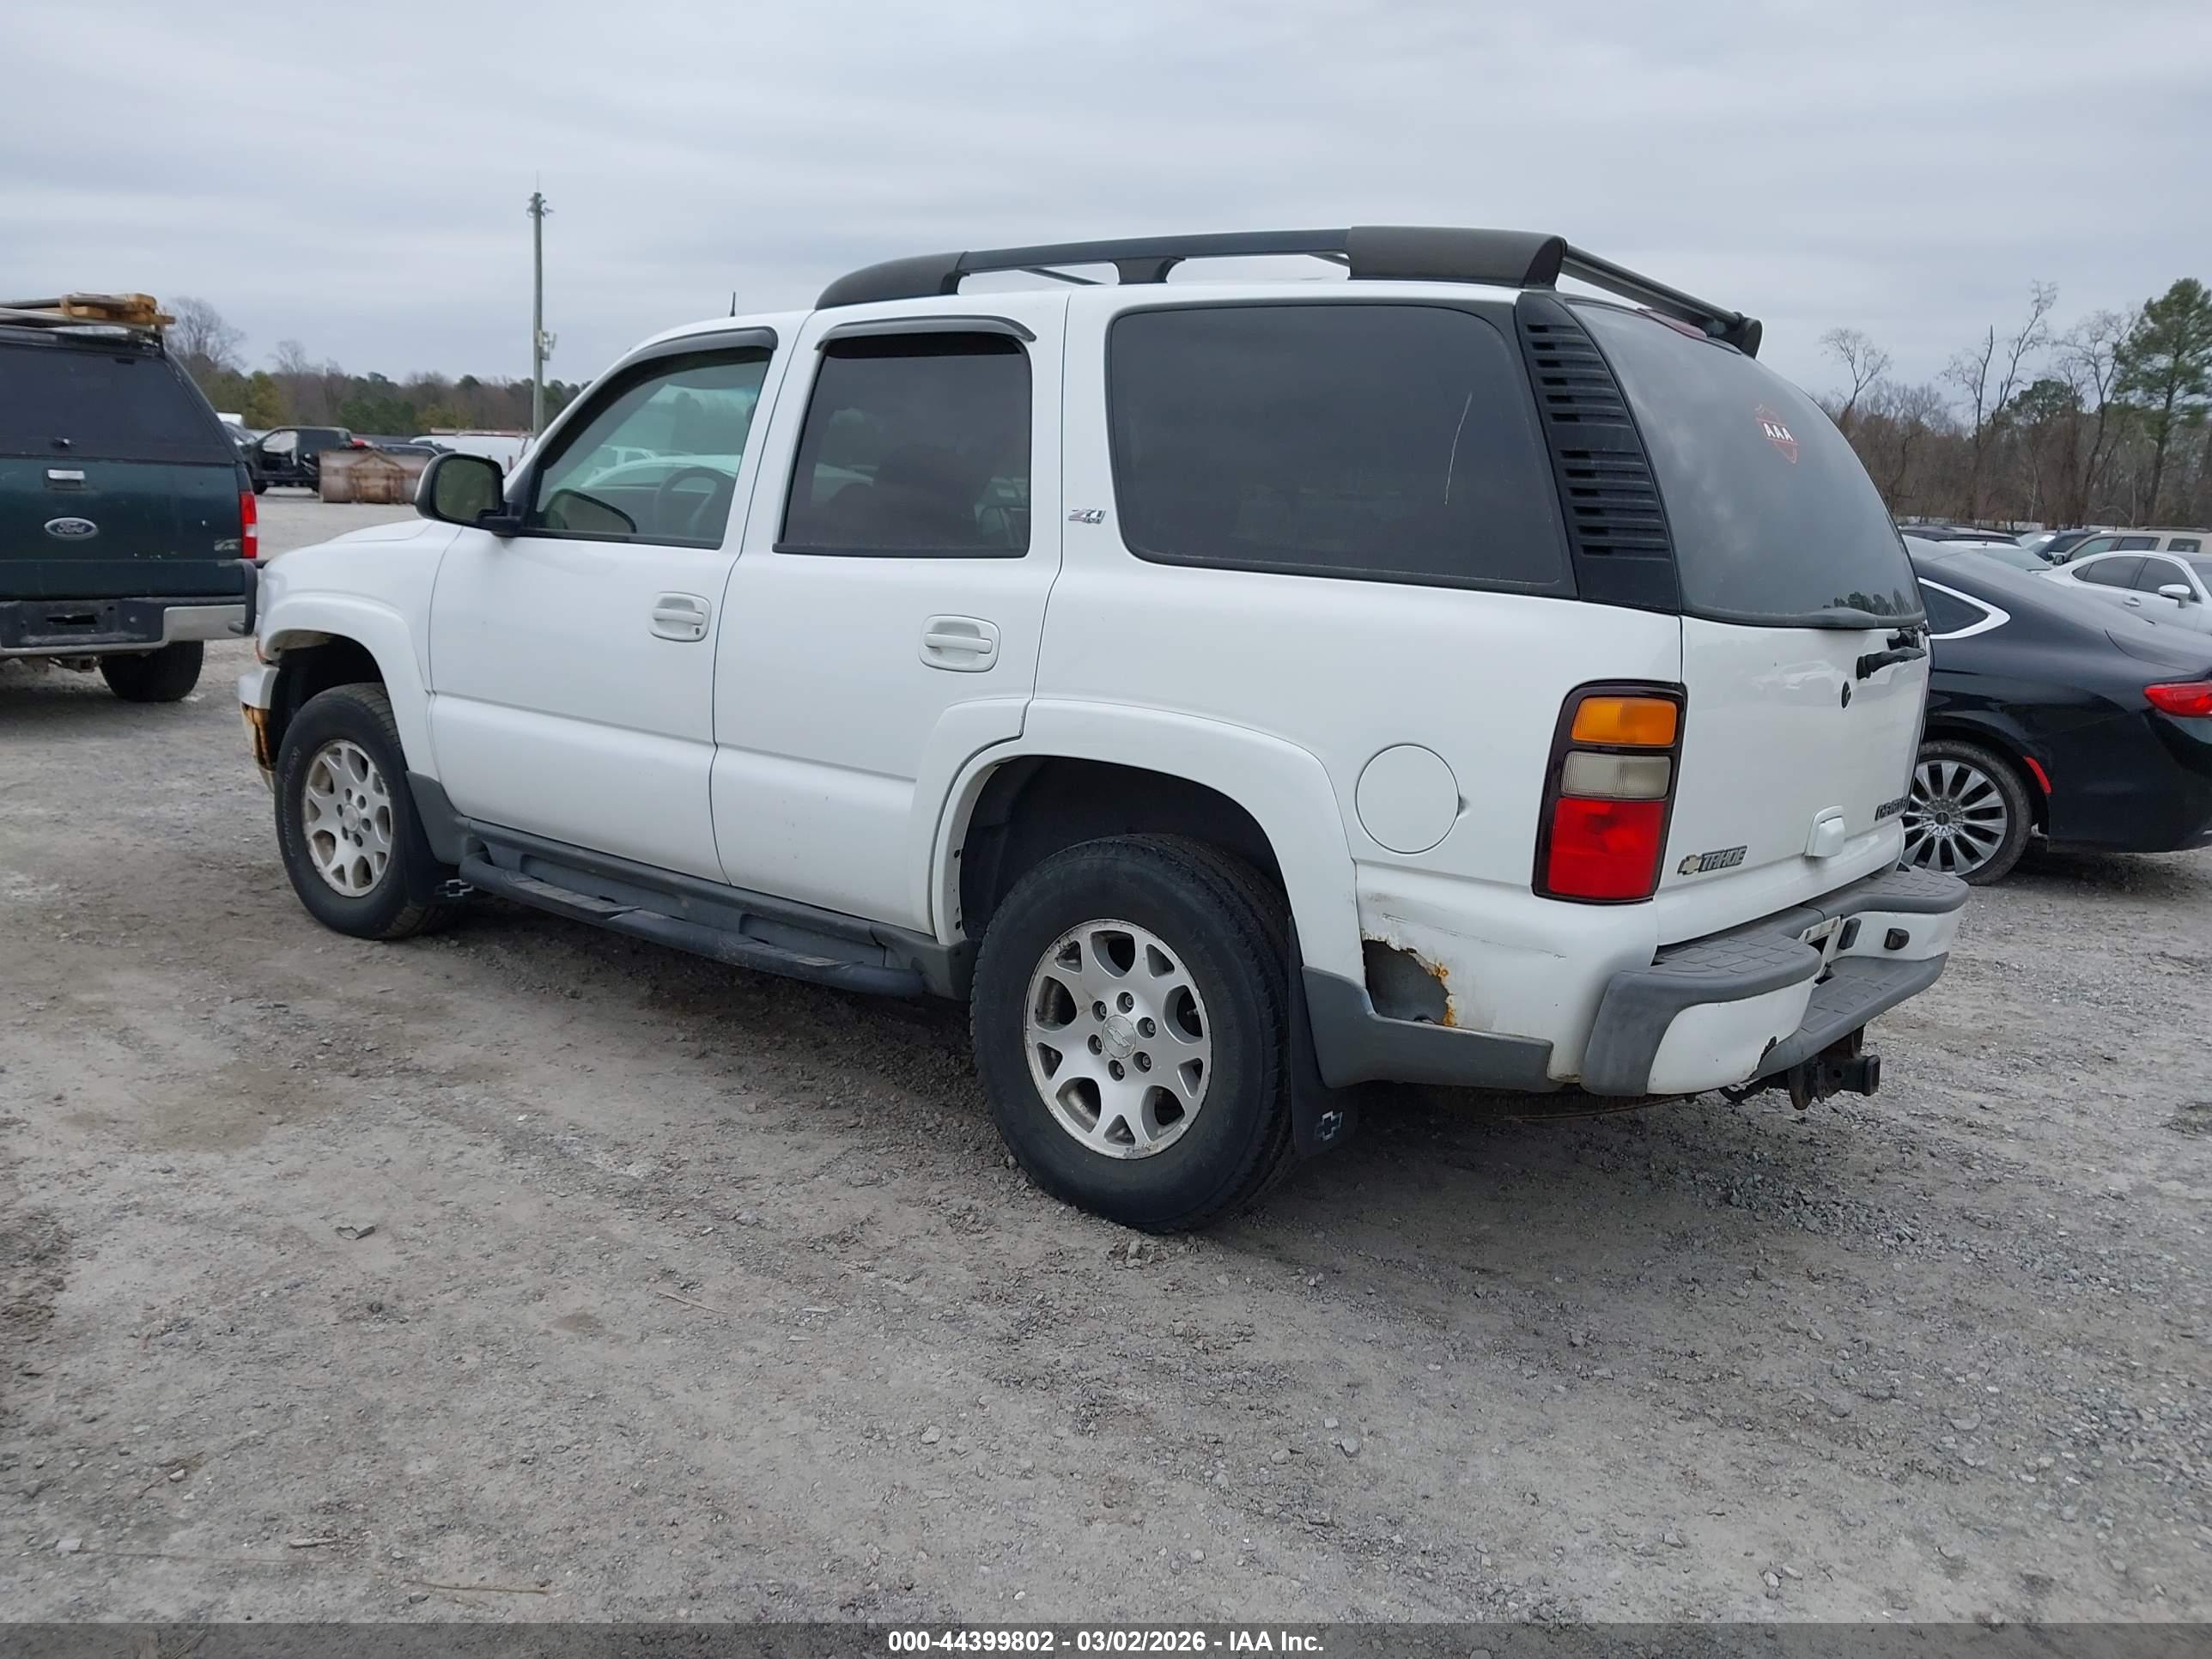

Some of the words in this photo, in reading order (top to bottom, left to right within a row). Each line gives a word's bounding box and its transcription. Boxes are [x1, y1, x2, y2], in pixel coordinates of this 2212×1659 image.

[1763, 422, 1794, 441] AAA
[56, 520, 87, 535] Ford
[1699, 846, 1747, 872] TAHOE
